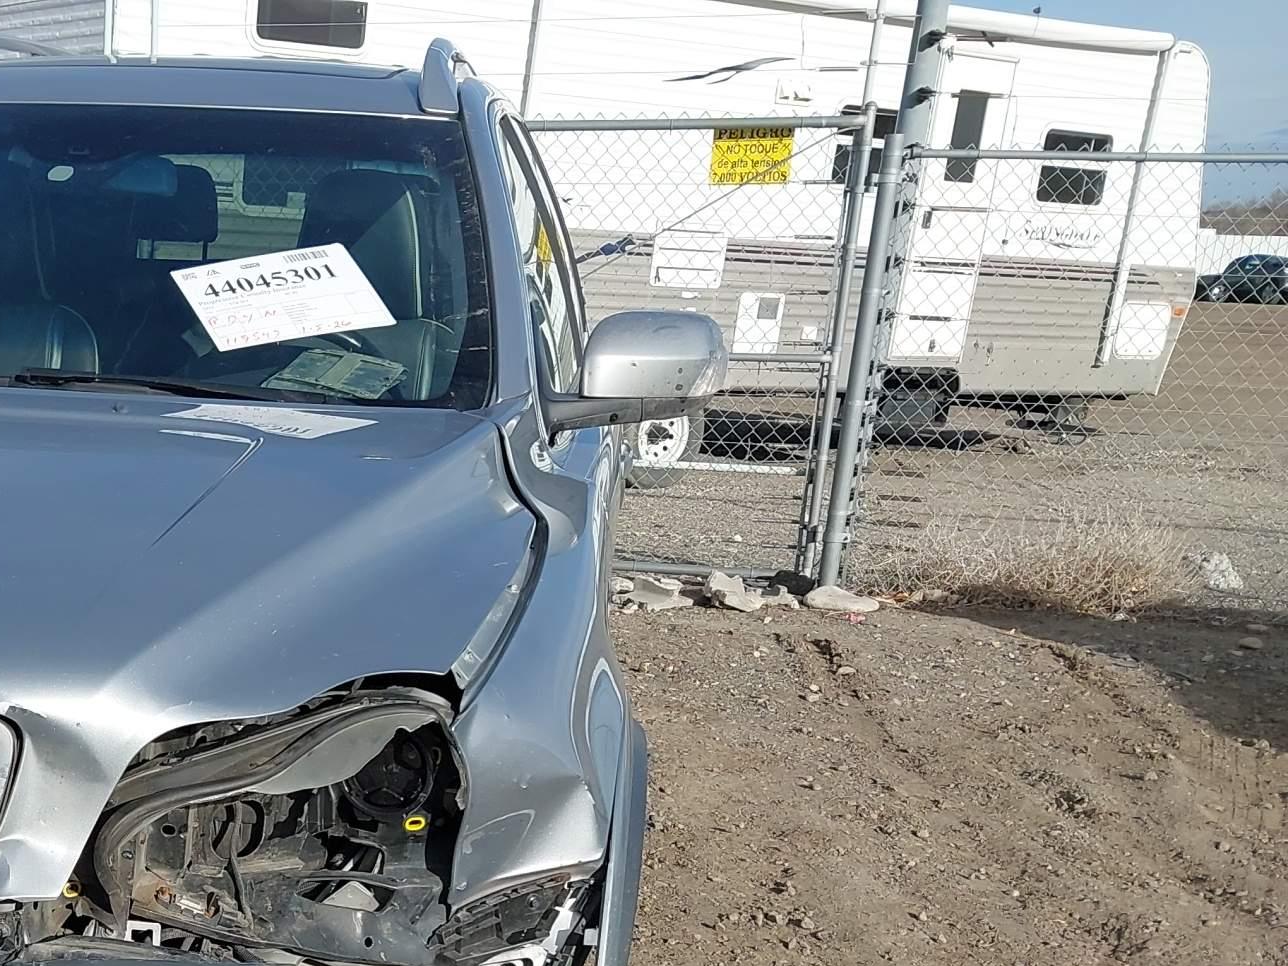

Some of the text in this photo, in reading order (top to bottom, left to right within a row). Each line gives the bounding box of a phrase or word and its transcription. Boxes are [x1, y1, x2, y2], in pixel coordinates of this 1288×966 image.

[717, 127, 792, 139] PELIGRO
[726, 143, 779, 154] NO TOQUE
[717, 159, 729, 168] de
[732, 159, 748, 169] alta
[204, 264, 337, 298] 44045301
